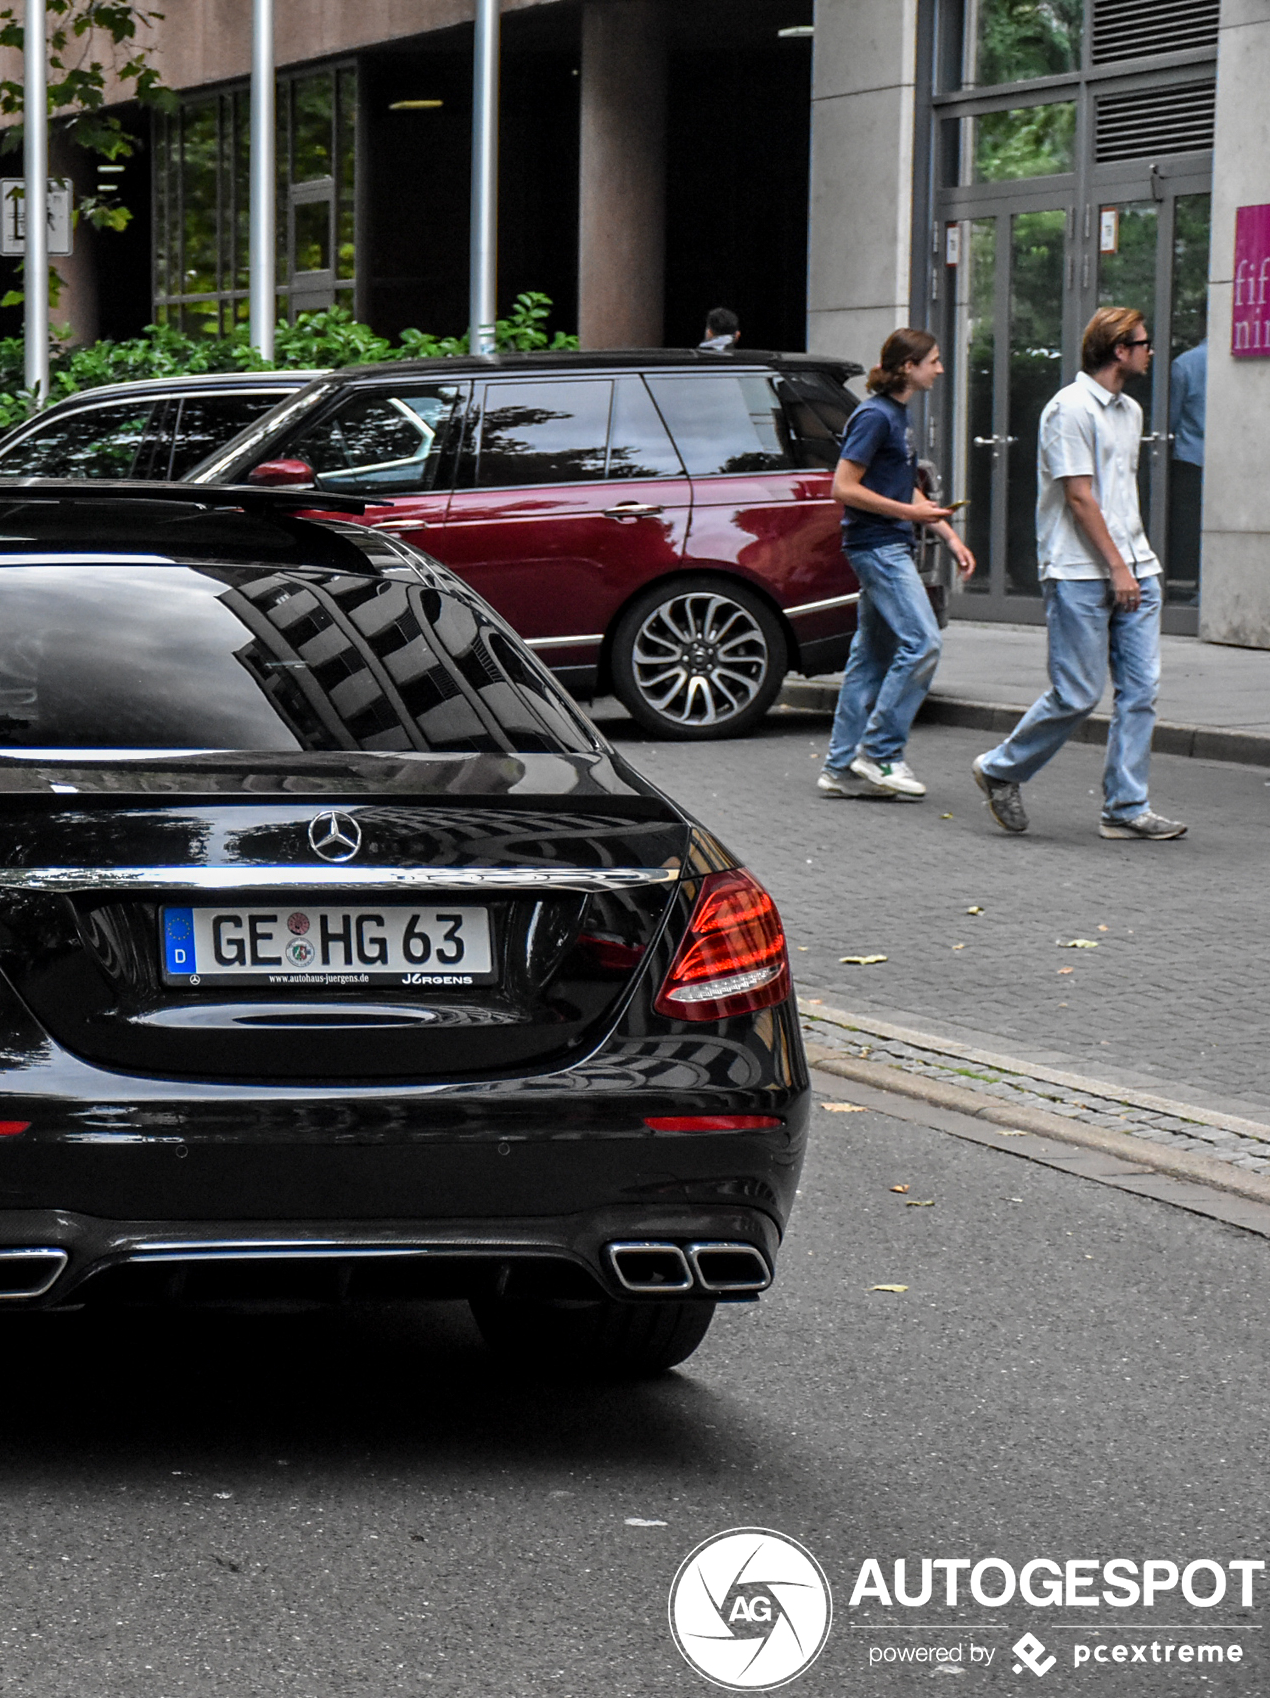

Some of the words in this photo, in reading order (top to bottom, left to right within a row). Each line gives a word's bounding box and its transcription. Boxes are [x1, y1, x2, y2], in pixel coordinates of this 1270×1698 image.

[175, 949, 186, 964] D
[212, 914, 282, 967] GE
[319, 914, 388, 966] HG
[402, 914, 465, 966] 63
[269, 973, 369, 984] www.autohaus-juergens.de
